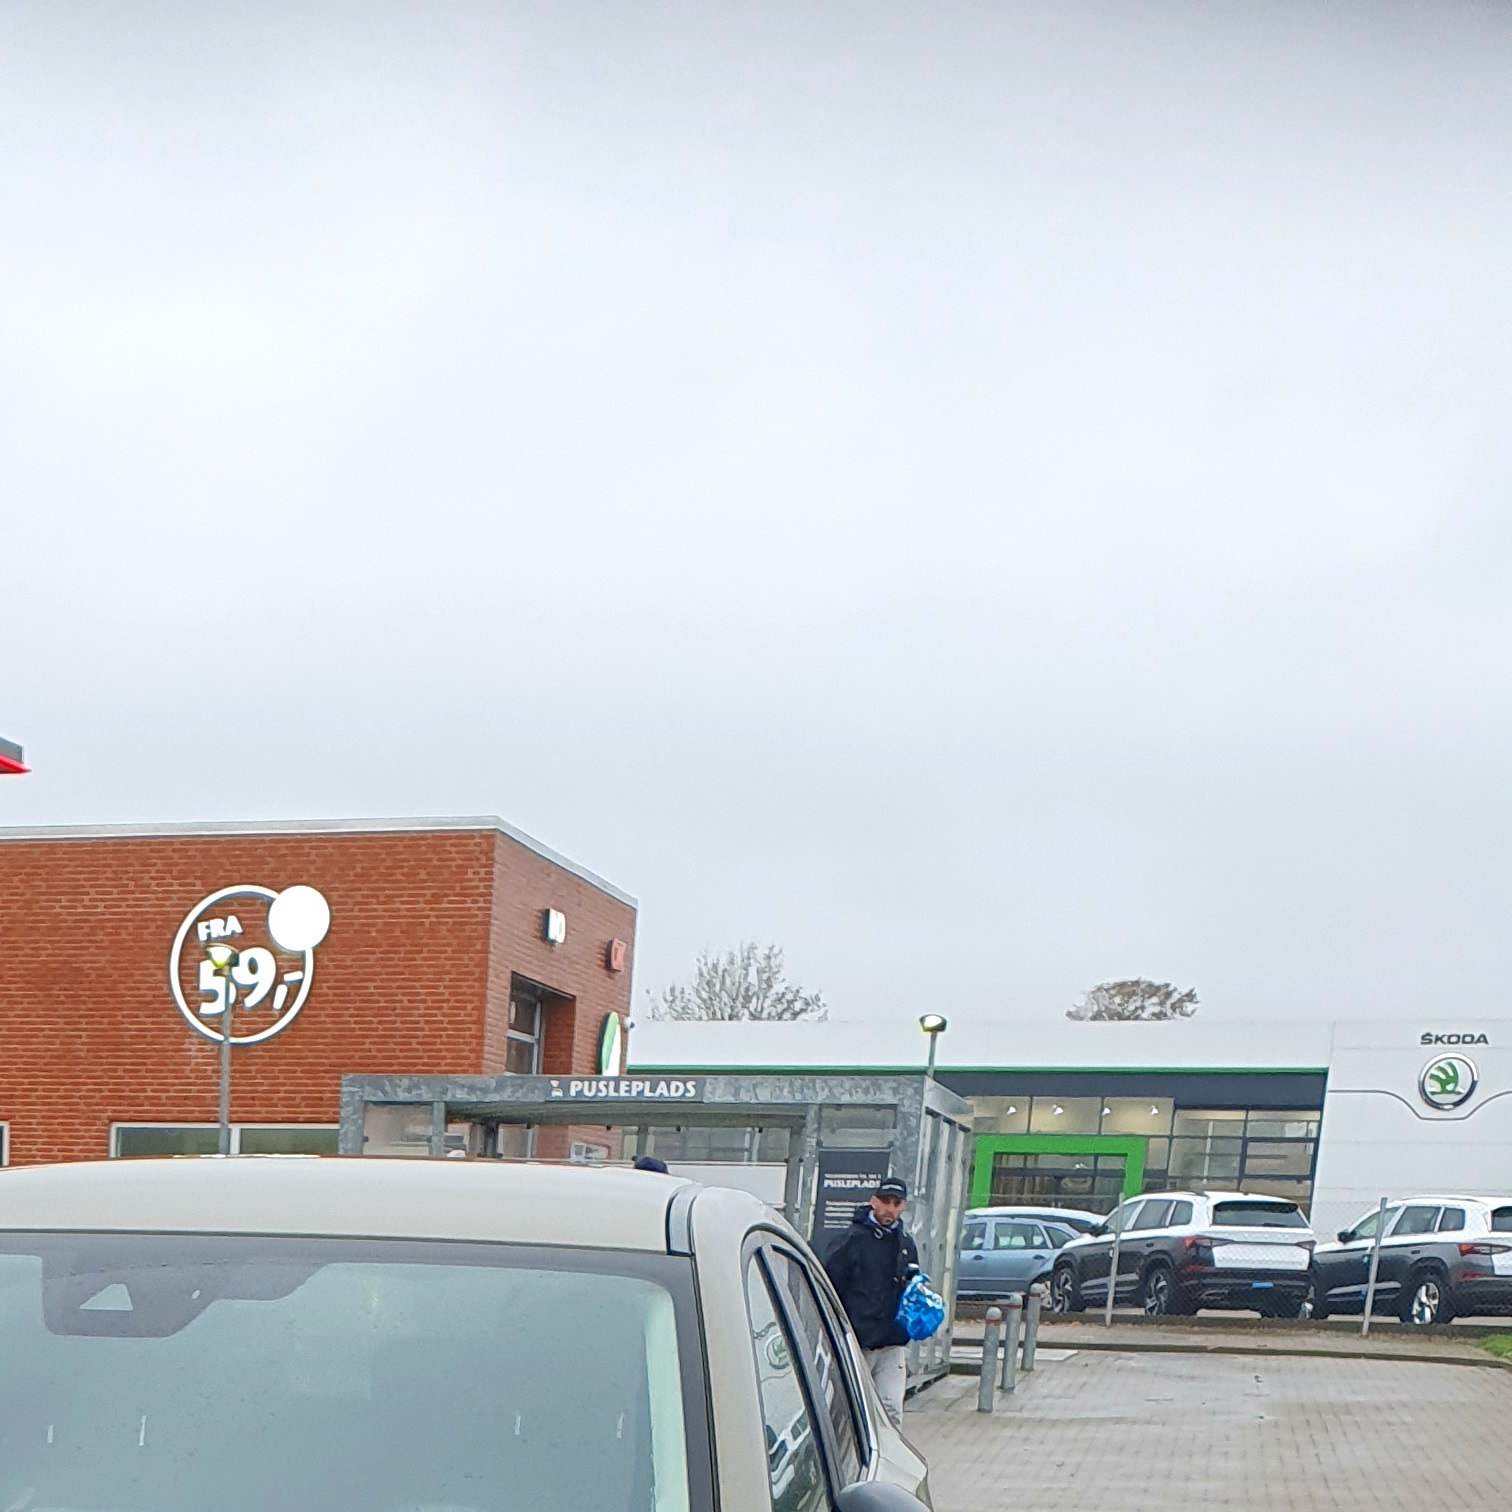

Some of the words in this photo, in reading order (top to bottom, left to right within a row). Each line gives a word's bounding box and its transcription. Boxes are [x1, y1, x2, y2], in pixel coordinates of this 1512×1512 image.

[197, 915, 243, 941] FRA
[1420, 1032, 1489, 1045] ŠKODA
[569, 1080, 696, 1097] PUSLEPLADS
